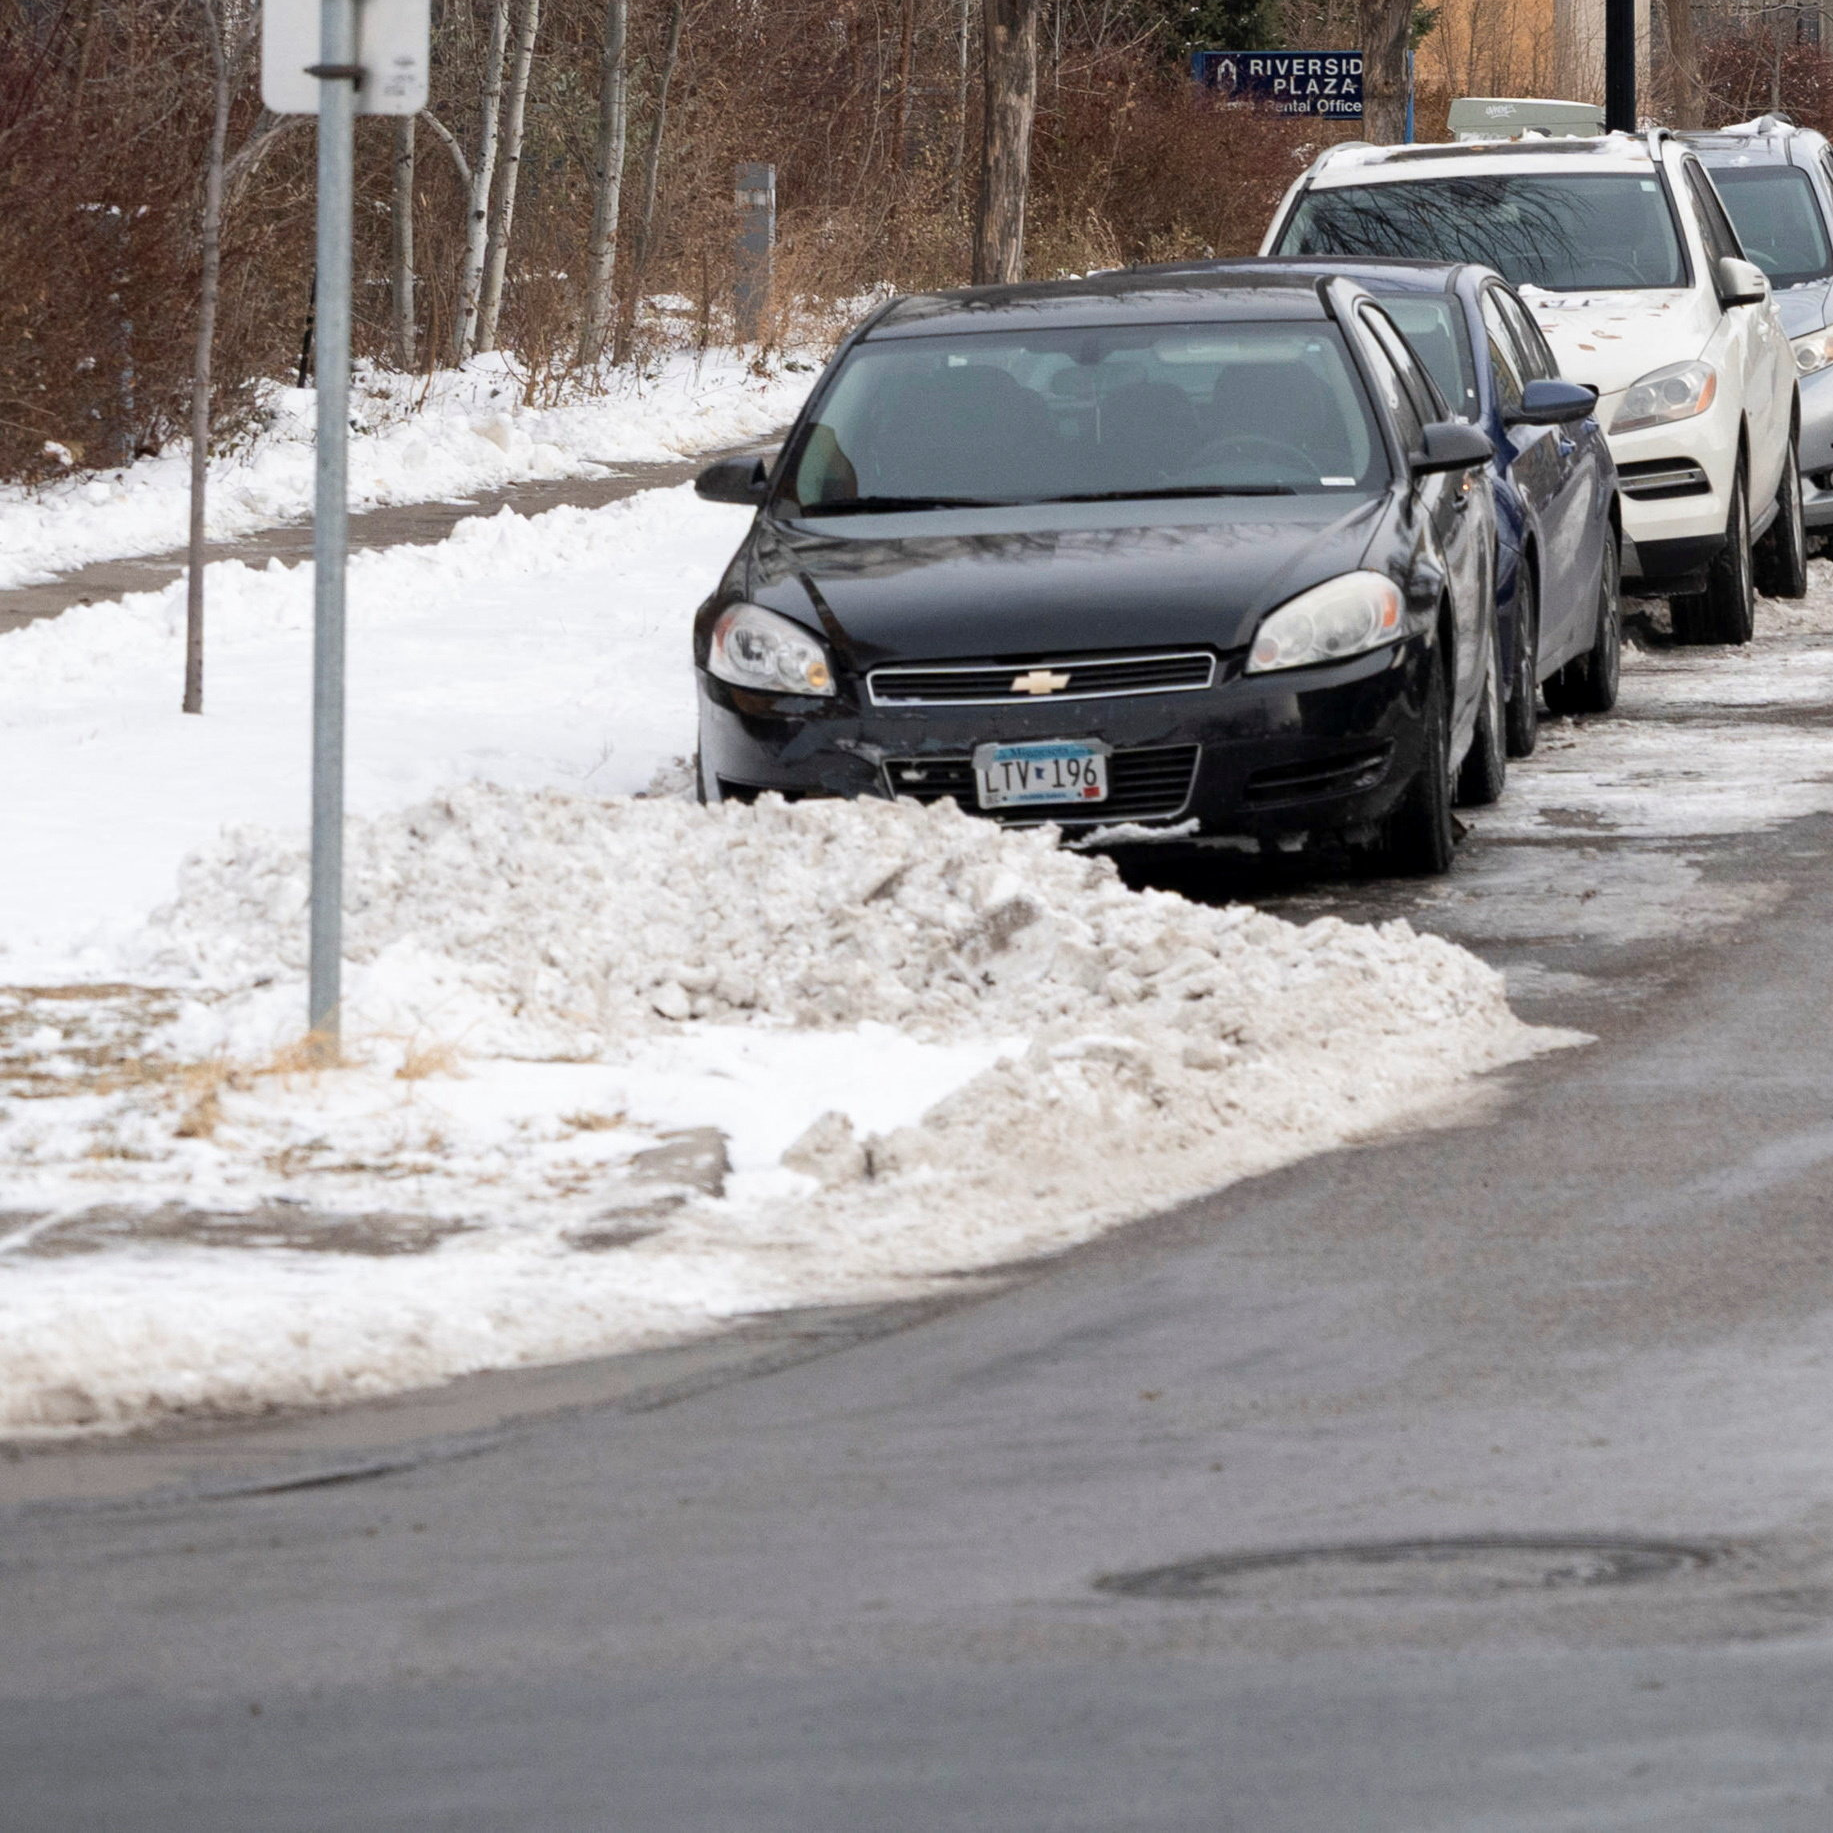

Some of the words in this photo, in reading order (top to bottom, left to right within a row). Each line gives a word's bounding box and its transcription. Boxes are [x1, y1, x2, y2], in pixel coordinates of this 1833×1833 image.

[1250, 59, 1362, 76] RIVERSID
[1274, 78, 1356, 95] PLAZA
[1317, 99, 1362, 112] Office
[985, 760, 1029, 793] LTV
[1052, 757, 1097, 788] 196
